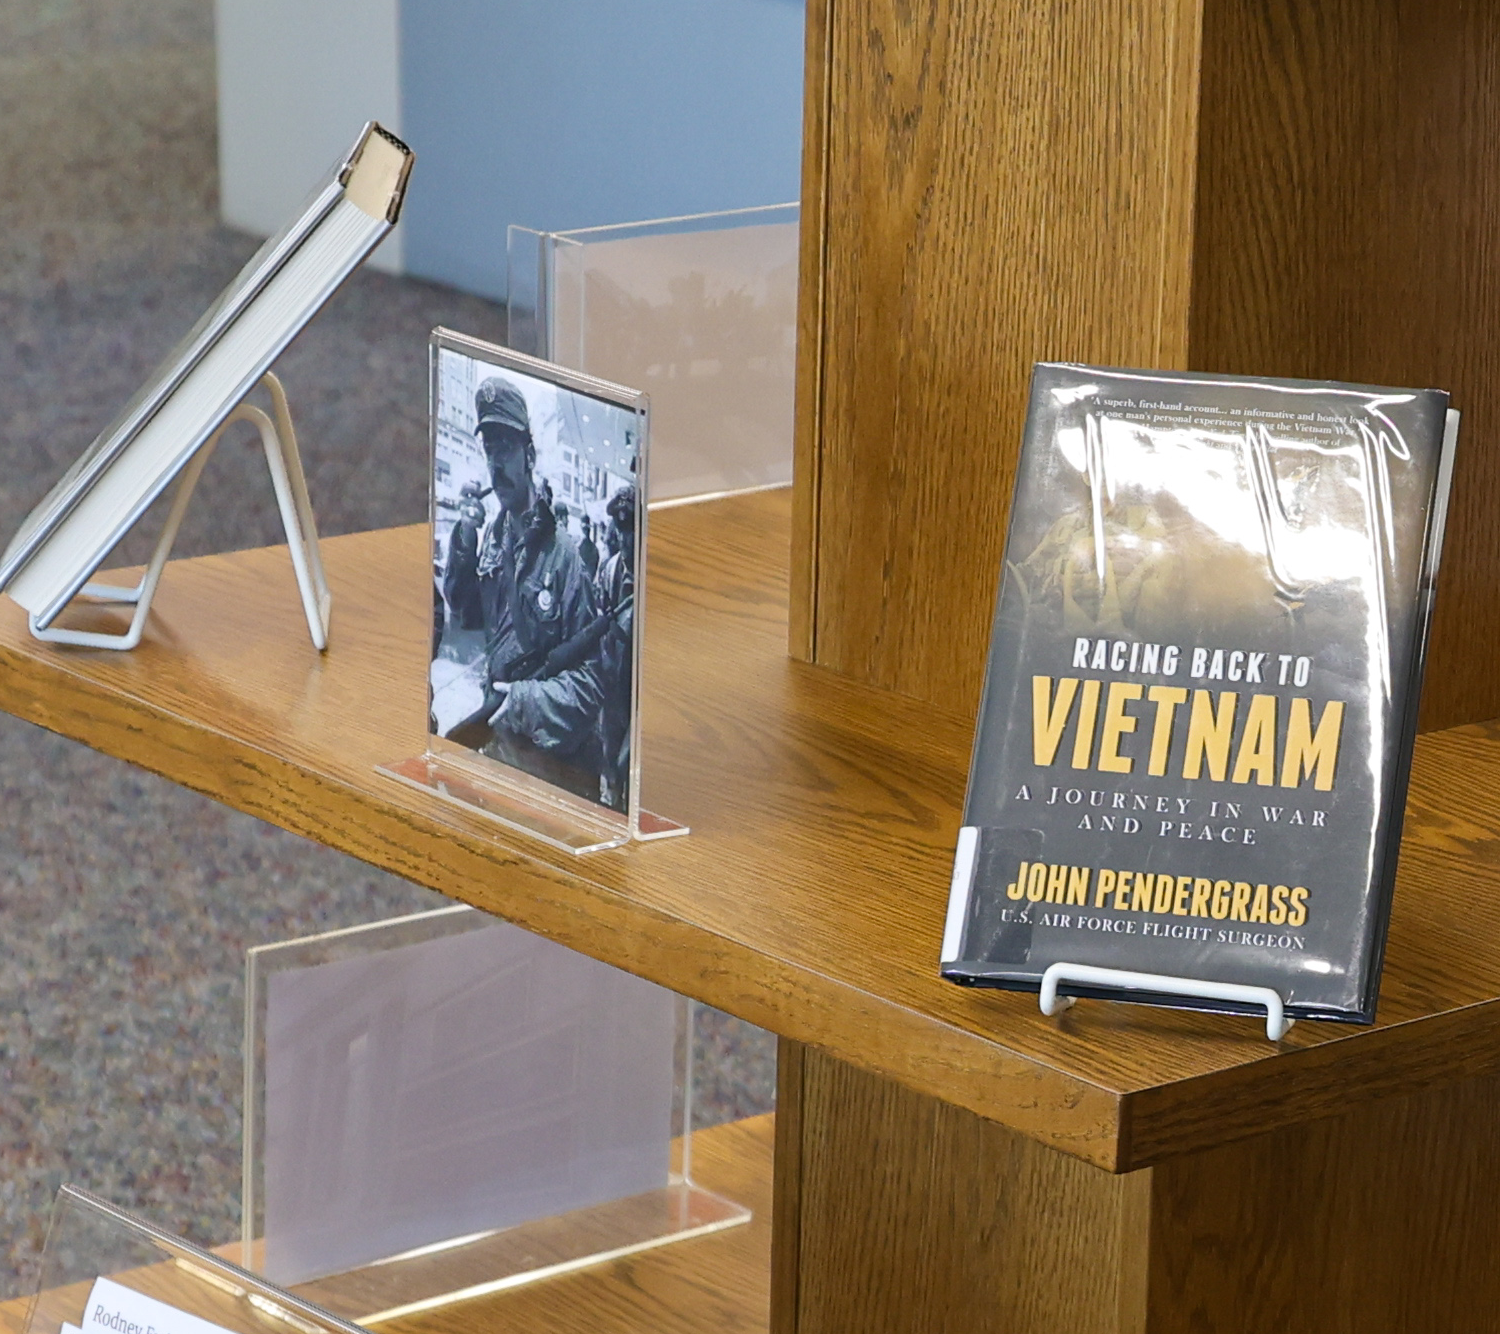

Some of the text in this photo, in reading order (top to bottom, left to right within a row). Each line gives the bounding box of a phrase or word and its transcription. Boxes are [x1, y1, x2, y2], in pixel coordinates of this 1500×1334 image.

[1126, 411, 1151, 420] man's
[1153, 414, 1191, 426] personal
[1194, 417, 1242, 429] experience
[1277, 422, 1291, 431] the
[1294, 423, 1332, 434] Vietnam
[1139, 399, 1181, 411] first-hand
[1244, 406, 1295, 420] informative
[1297, 412, 1314, 421] and
[1317, 412, 1347, 424] honest
[1072, 637, 1311, 687] RACING BACK TO
[1032, 675, 1345, 791] VIETNAM
[1015, 785, 1328, 827] A JOURNEY IN WAR
[1078, 814, 1256, 845] AND PEACE
[1007, 861, 1311, 927] JOHN PENDERGRASS
[1001, 909, 1305, 950] U.S. AIR FORCE FLIGHT SURGEON
